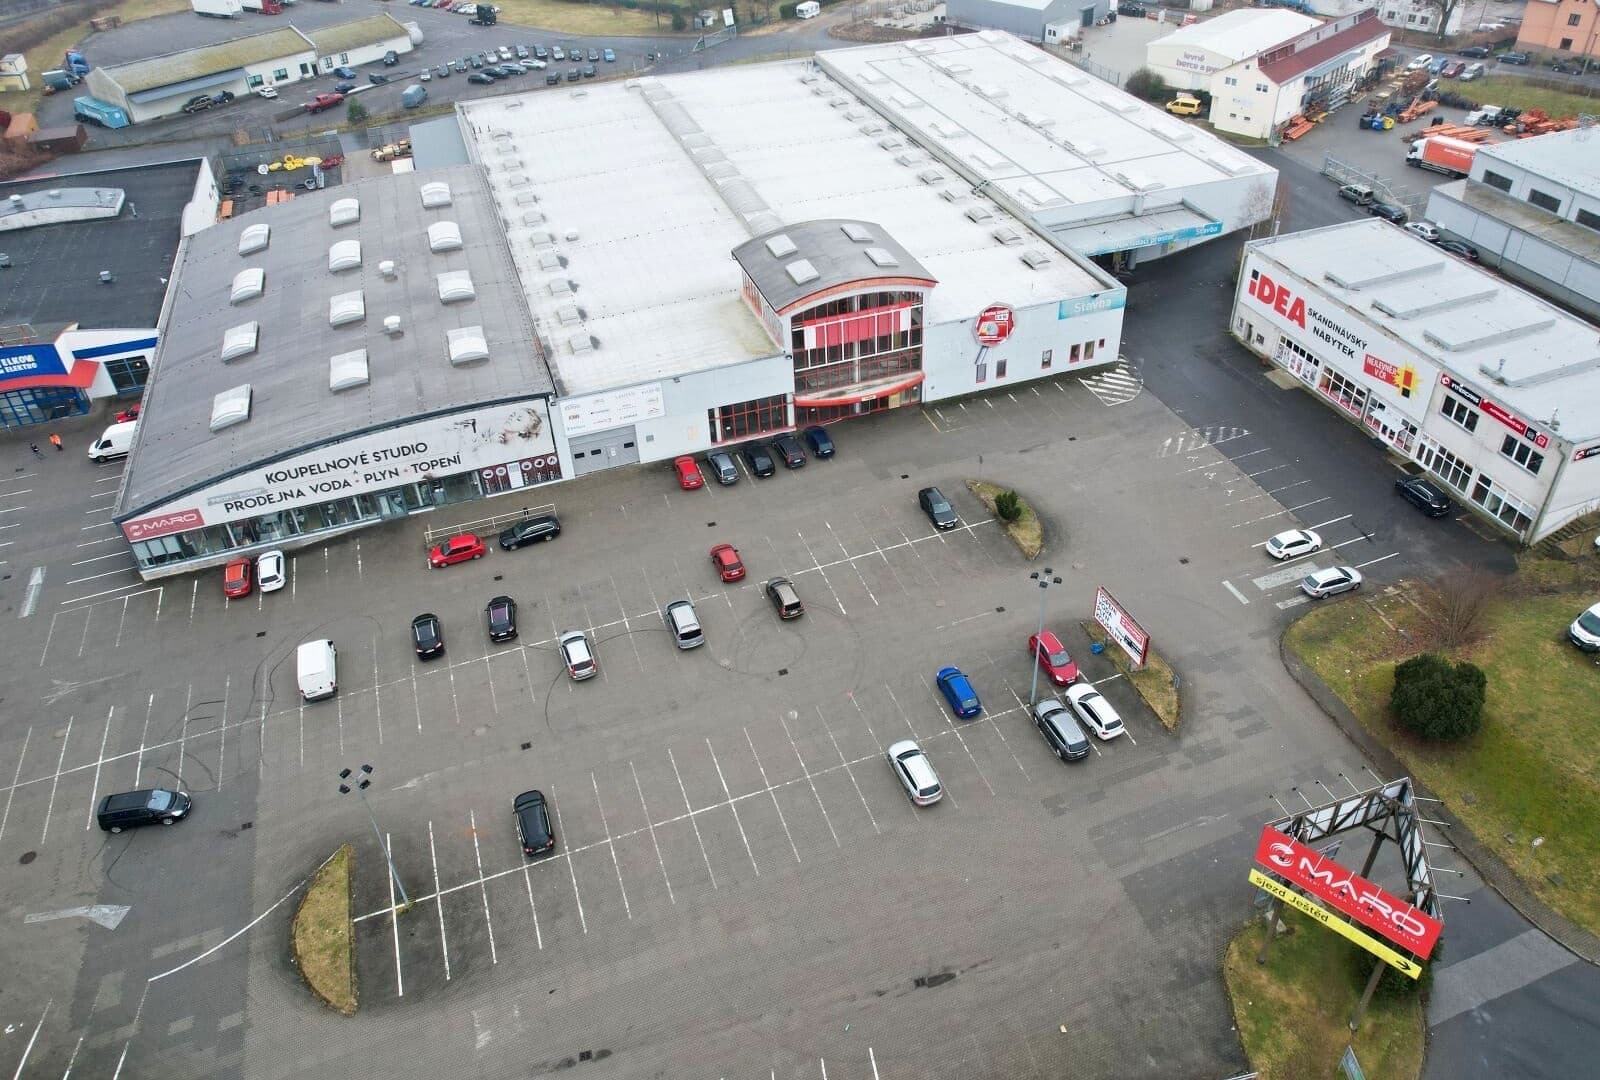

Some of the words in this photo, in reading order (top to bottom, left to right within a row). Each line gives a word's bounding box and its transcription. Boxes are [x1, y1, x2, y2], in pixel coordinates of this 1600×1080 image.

[1074, 298, 1112, 313] Stavba
[1248, 269, 1306, 330] iDEA
[224, 487, 306, 513] PRODEJNA
[309, 478, 352, 495] VODA
[364, 467, 399, 484] PLYN
[411, 451, 462, 475] TOPENÍ
[265, 450, 369, 484] KOUPELNOVÉ
[374, 442, 428, 462] STUDIO
[143, 513, 197, 531] MARO
[1255, 877, 1286, 898] sjezd
[1299, 857, 1425, 937] MARO
